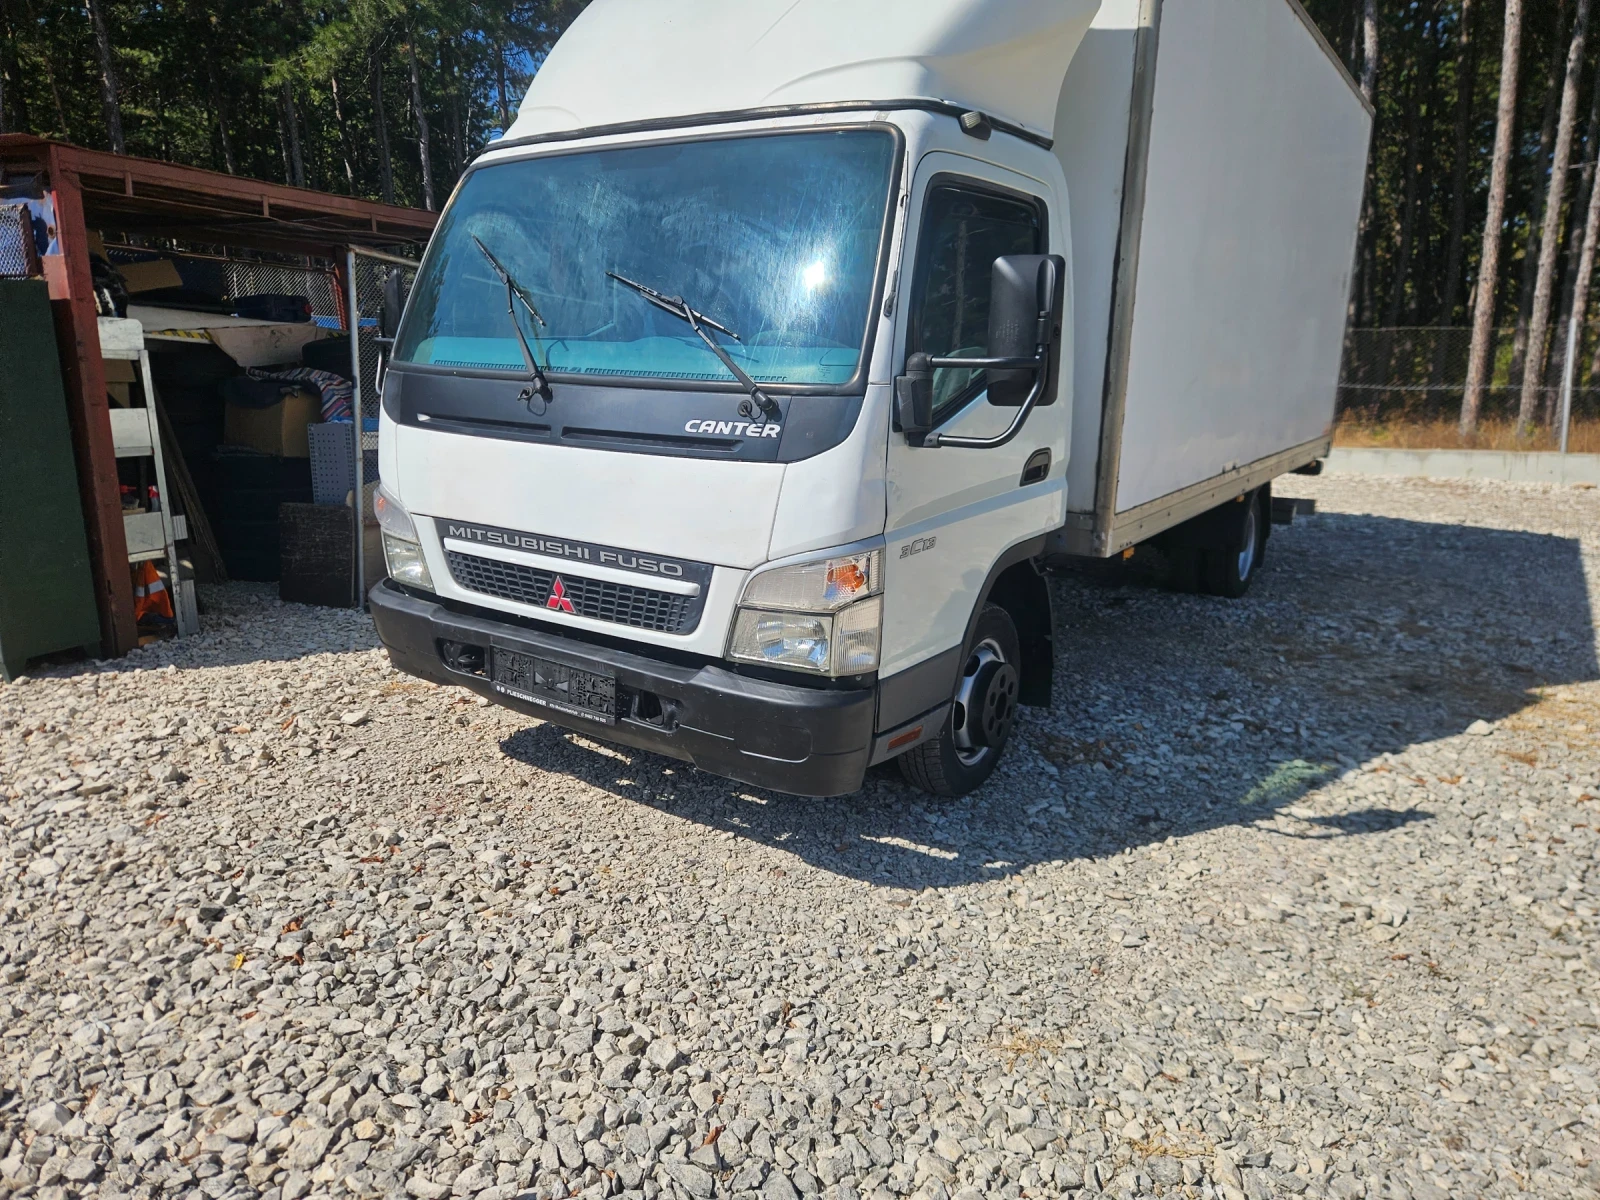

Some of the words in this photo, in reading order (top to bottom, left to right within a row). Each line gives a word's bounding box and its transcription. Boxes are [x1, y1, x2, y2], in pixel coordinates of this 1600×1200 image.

[684, 419, 781, 438] CANTER
[448, 525, 590, 560] MITSUBISHI
[599, 550, 683, 577] FUSO
[899, 536, 937, 560] 3C13
